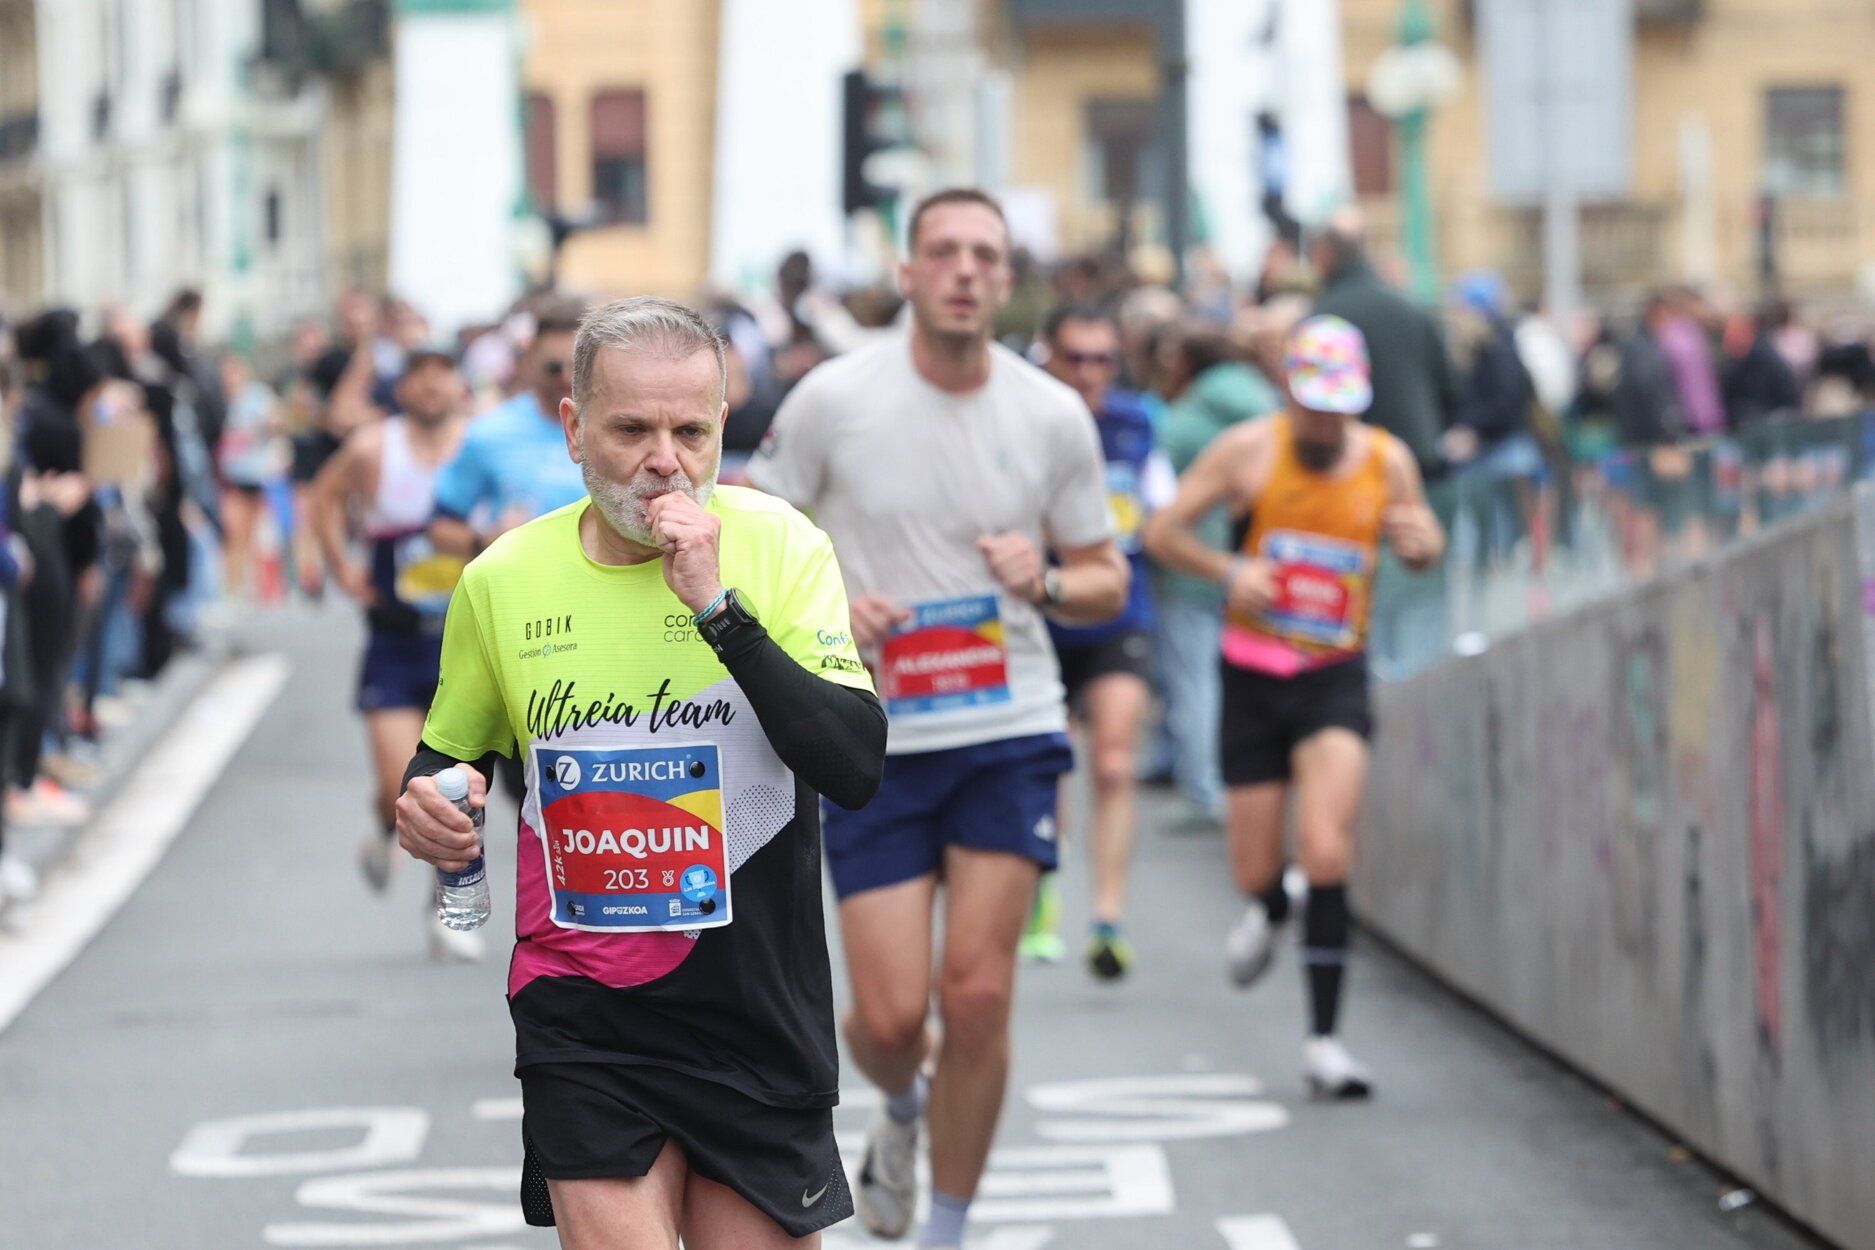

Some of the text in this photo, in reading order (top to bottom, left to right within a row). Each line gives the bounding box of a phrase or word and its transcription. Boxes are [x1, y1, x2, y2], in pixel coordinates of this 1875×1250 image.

[525, 614, 573, 641] GOBIK
[526, 678, 736, 741] Ultreia team
[591, 760, 686, 783] ZURICH
[561, 824, 710, 860] JOAQUIN
[602, 868, 650, 891] 203
